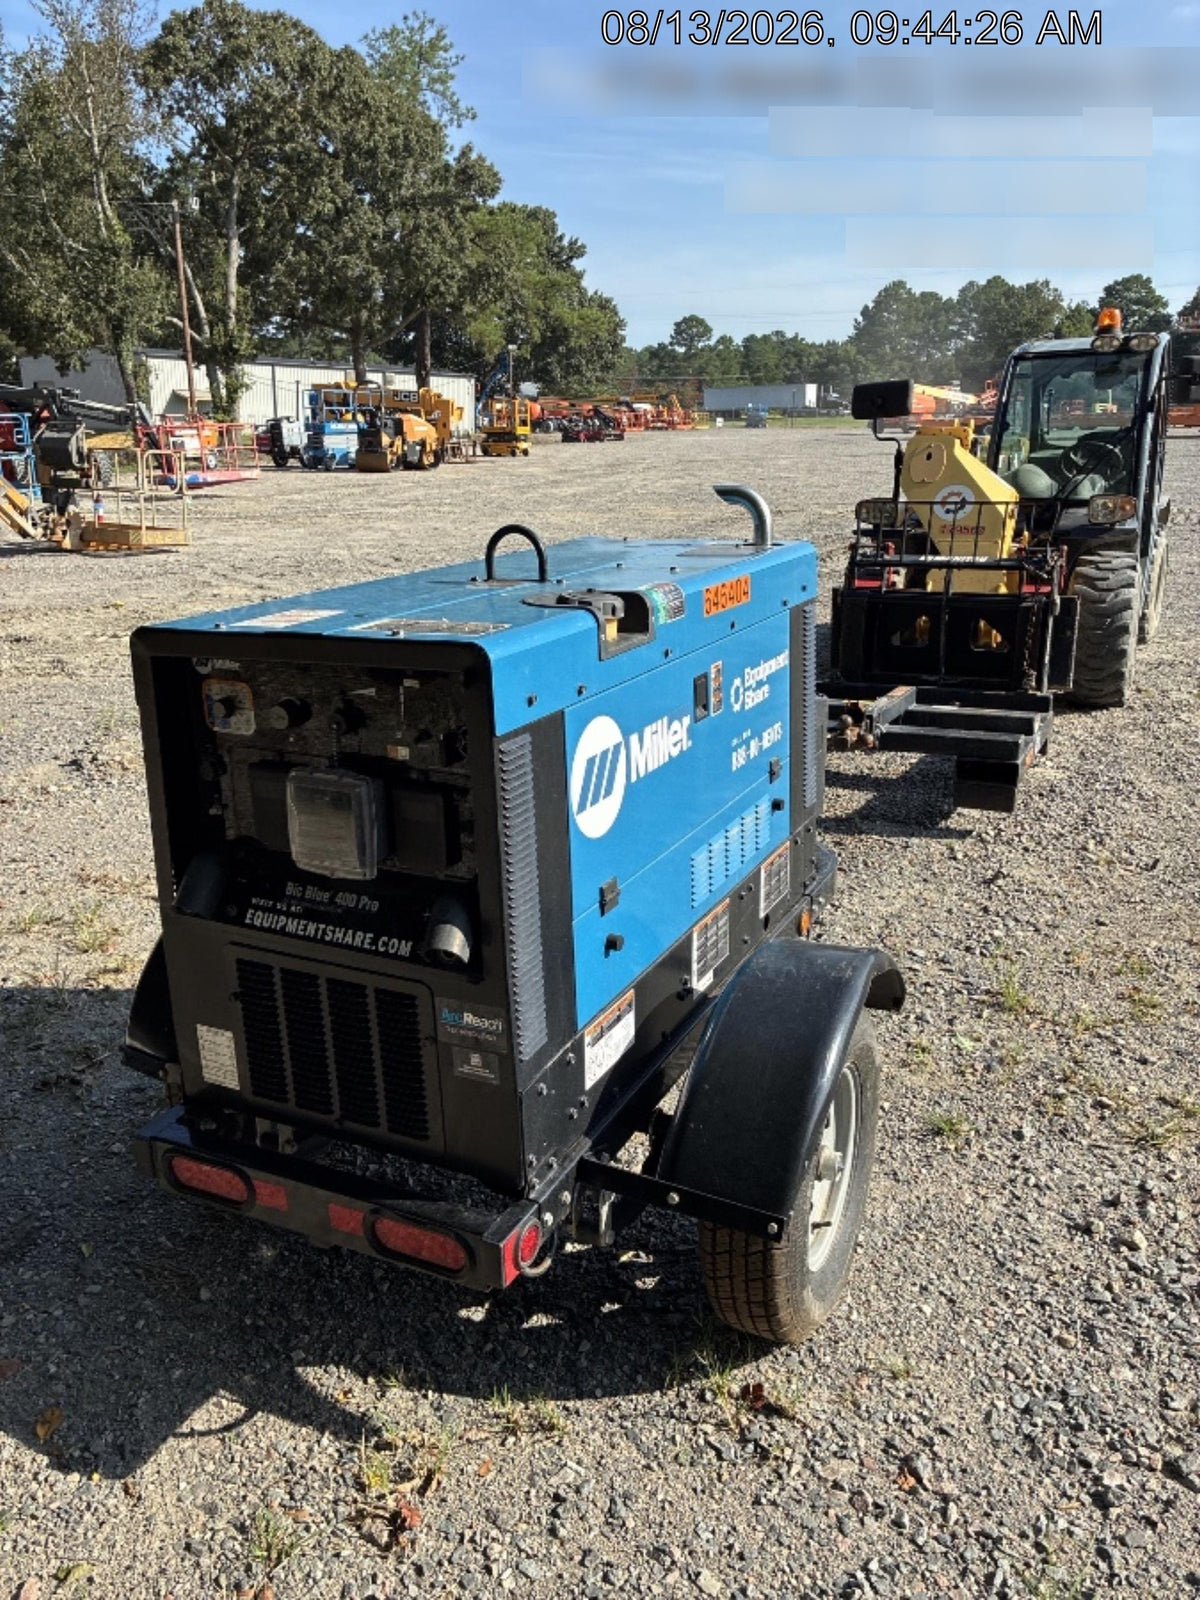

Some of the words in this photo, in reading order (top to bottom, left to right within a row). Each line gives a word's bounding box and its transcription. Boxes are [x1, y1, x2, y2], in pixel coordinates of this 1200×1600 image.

[393, 390, 418, 403] JCB
[744, 684, 769, 710] Share
[629, 714, 692, 783] Miller
[285, 882, 303, 897] Big
[304, 885, 330, 902] Blue
[334, 891, 358, 908] 400
[358, 895, 380, 913] Pro
[245, 908, 413, 957] EQUIPMENTSHARE.COM
